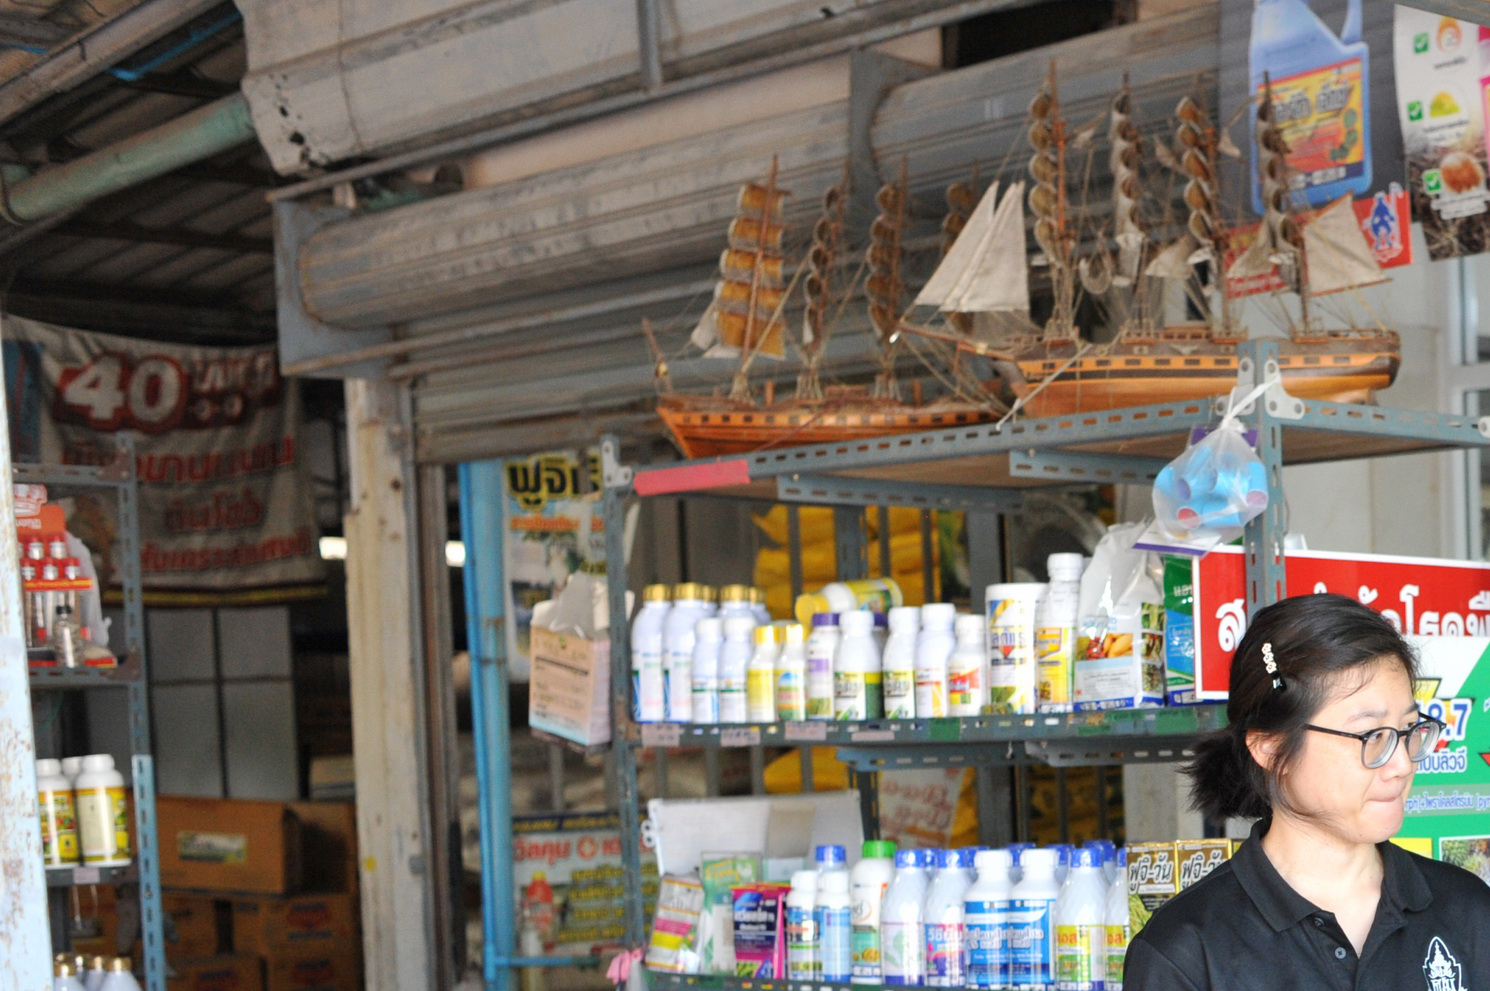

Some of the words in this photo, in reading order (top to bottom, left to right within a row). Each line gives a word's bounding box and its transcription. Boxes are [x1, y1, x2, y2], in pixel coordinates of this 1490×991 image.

[63, 355, 181, 424] 40
[1130, 853, 1173, 893] ฟูจิ-วัน
